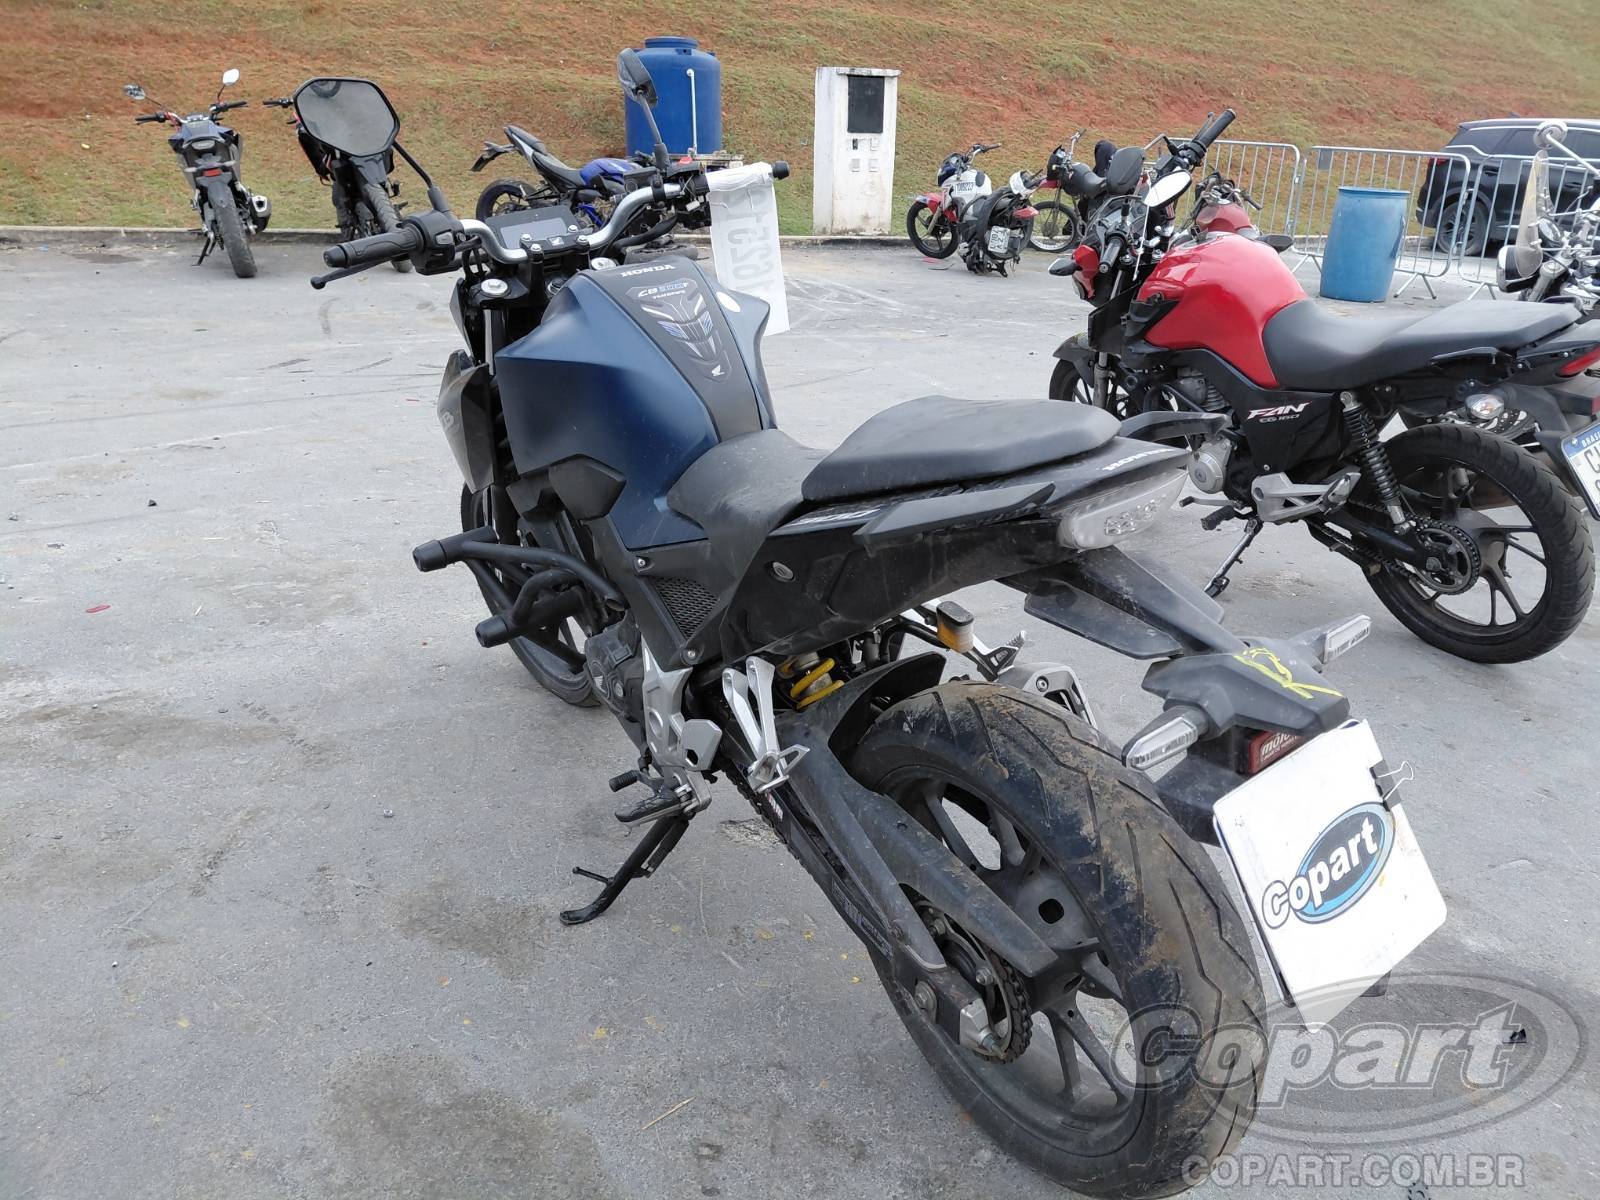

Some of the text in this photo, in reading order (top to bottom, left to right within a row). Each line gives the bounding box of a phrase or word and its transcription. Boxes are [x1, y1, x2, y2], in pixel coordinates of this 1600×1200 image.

[620, 264, 676, 278] HONDA
[1247, 402, 1311, 420] FAN
[1262, 817, 1379, 930] Copart
